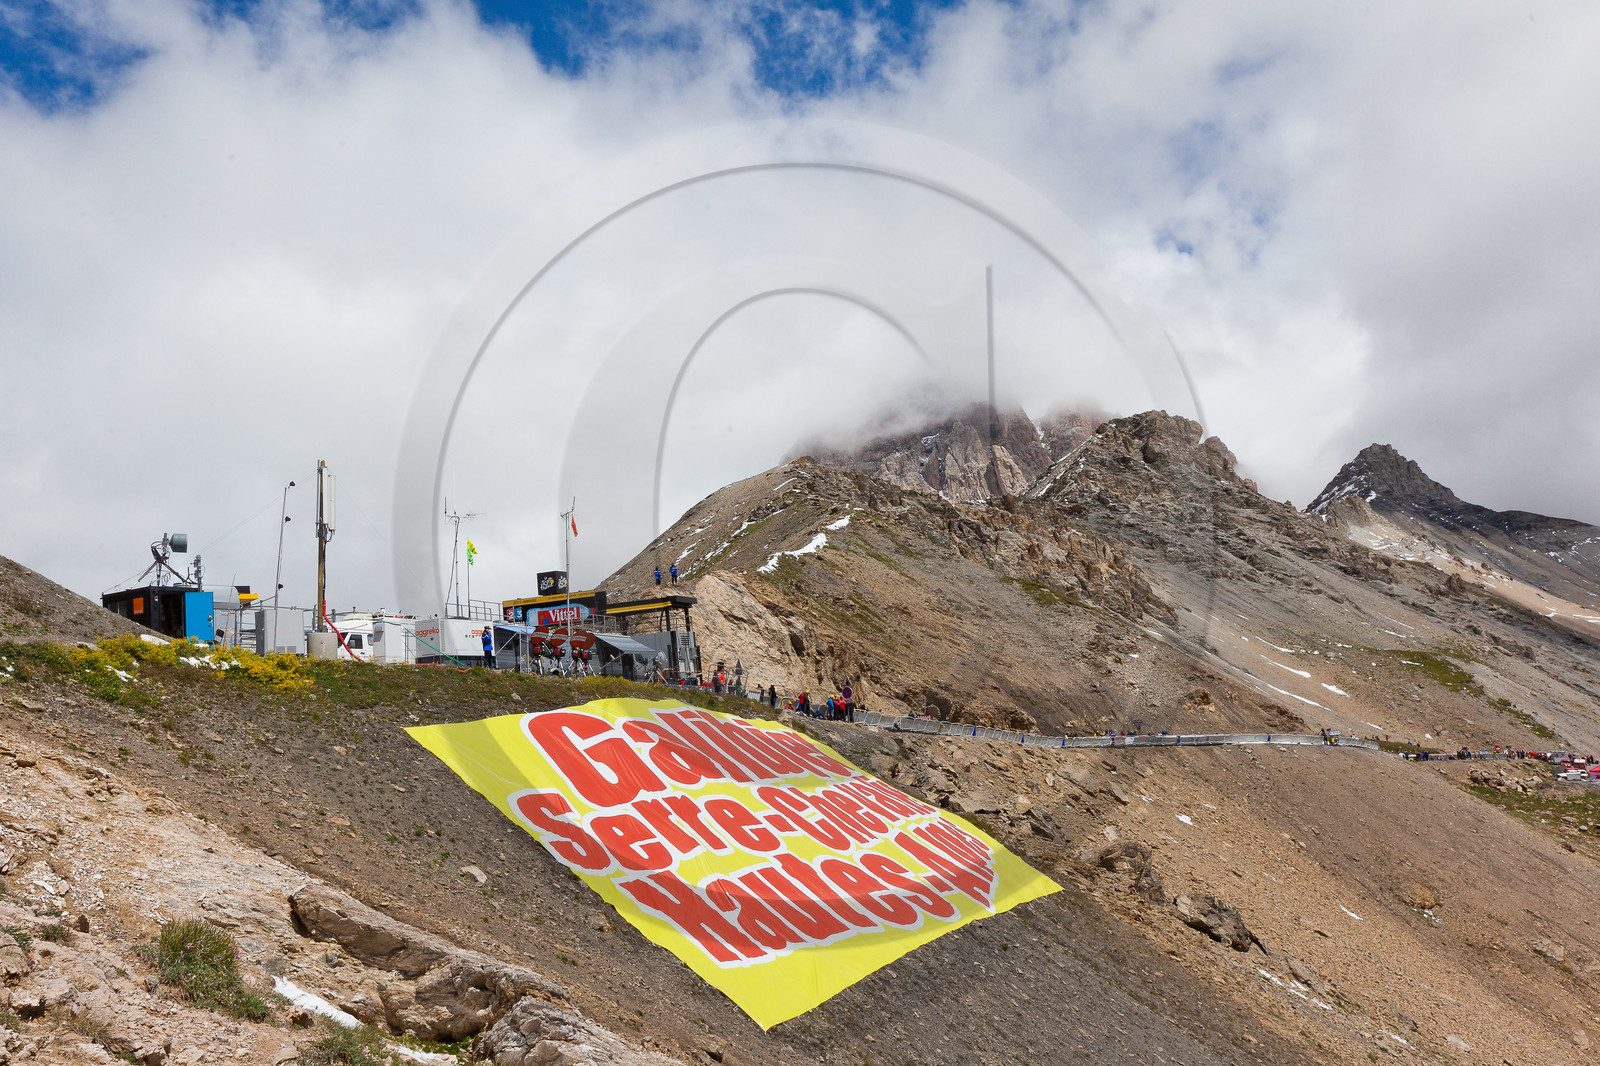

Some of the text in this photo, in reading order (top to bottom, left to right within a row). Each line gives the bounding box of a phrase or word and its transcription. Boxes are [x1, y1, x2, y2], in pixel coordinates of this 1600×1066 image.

[415, 626, 440, 638] aggreko
[516, 610, 522, 618] 3
[548, 607, 578, 622] Vittel
[526, 710, 862, 808] Galibier
[515, 775, 938, 872] Serre-Chevalier
[618, 822, 994, 963] Hautes-Alpes
